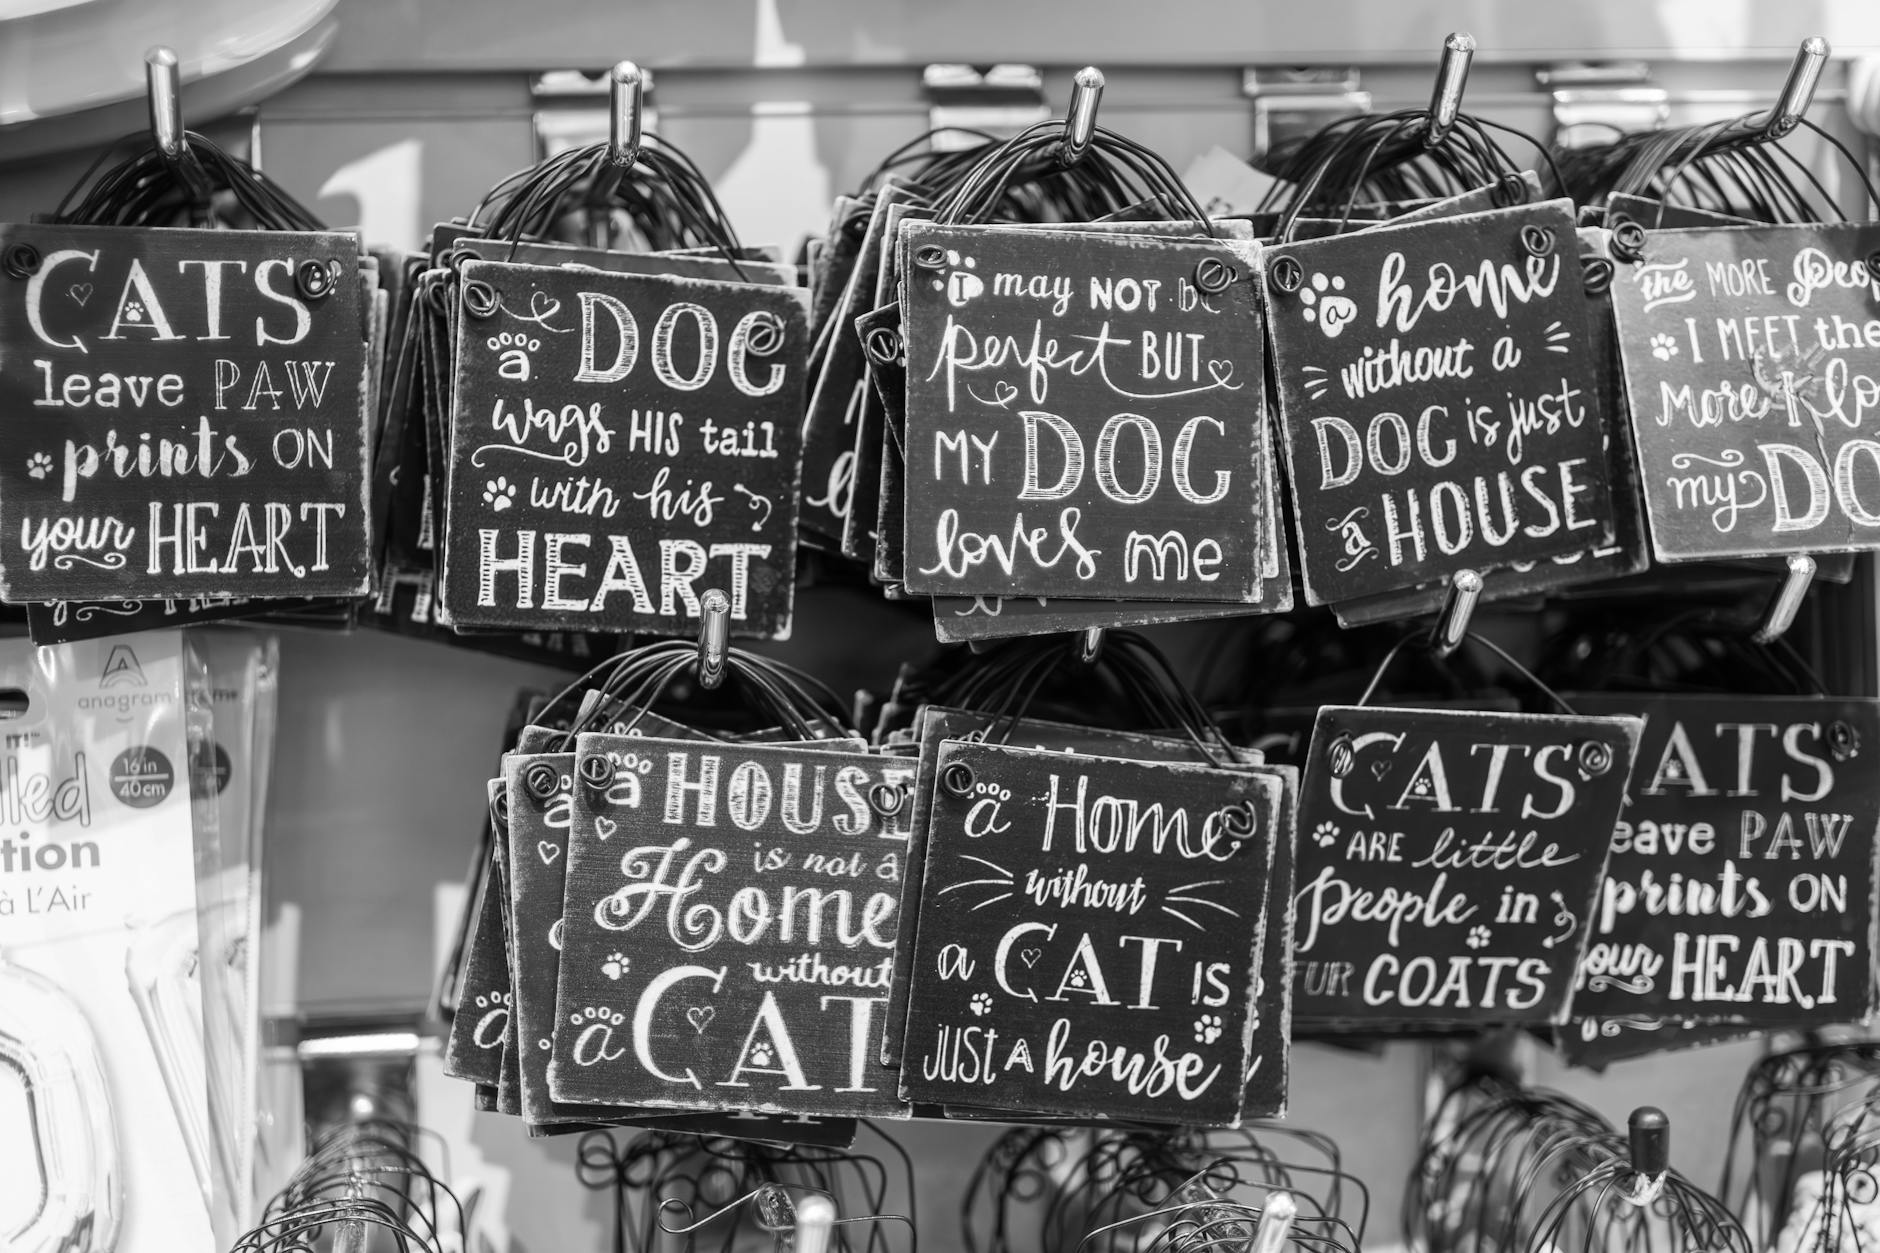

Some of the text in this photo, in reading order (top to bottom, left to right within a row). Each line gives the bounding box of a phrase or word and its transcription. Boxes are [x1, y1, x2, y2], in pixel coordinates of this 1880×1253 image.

[25, 249, 312, 354] CATS
[993, 272, 1074, 317] may
[1090, 276, 1161, 312] NOT
[1376, 251, 1561, 332] home
[1641, 247, 1880, 307] the MORE Peo
[498, 292, 787, 397] a DOG
[1142, 331, 1205, 381] BUT
[1341, 336, 1521, 398] without a
[1684, 318, 1704, 363] I
[1716, 315, 1800, 361] MEET
[32, 359, 336, 411] leave PAW
[61, 416, 333, 501] prints ON
[629, 409, 683, 456] HIS
[700, 418, 778, 458] tail
[935, 429, 999, 485] MY
[1017, 411, 1232, 504] DOG
[1310, 378, 1586, 490] DOG is just
[531, 467, 725, 527] with his
[1341, 458, 1596, 566] a HOUSE
[1667, 470, 1767, 533] my
[20, 515, 135, 571] your
[147, 501, 346, 577] HEART
[477, 528, 773, 620] HEART
[919, 507, 1223, 582] loves me
[78, 690, 172, 713] anagram
[0, 752, 90, 828] led
[605, 771, 642, 808] a
[1329, 731, 1575, 820] CATS
[1624, 721, 1835, 806] ATS
[963, 774, 1242, 861] a Home
[1346, 827, 1581, 869] ARE little
[1609, 809, 1854, 860] eave PAW
[594, 837, 898, 952] Home
[754, 842, 899, 881] is not a
[1025, 863, 1147, 915] without
[1599, 859, 1847, 934] prints ON
[1495, 885, 1540, 923] in
[747, 952, 893, 988] without
[938, 944, 976, 980] a
[994, 922, 1183, 1009] CAT
[1363, 953, 1552, 1010] COATS
[1669, 932, 1855, 1009] HEART
[573, 965, 889, 1092] a CAT
[1004, 1038, 1034, 1072] A
[1044, 1018, 1221, 1100] house
